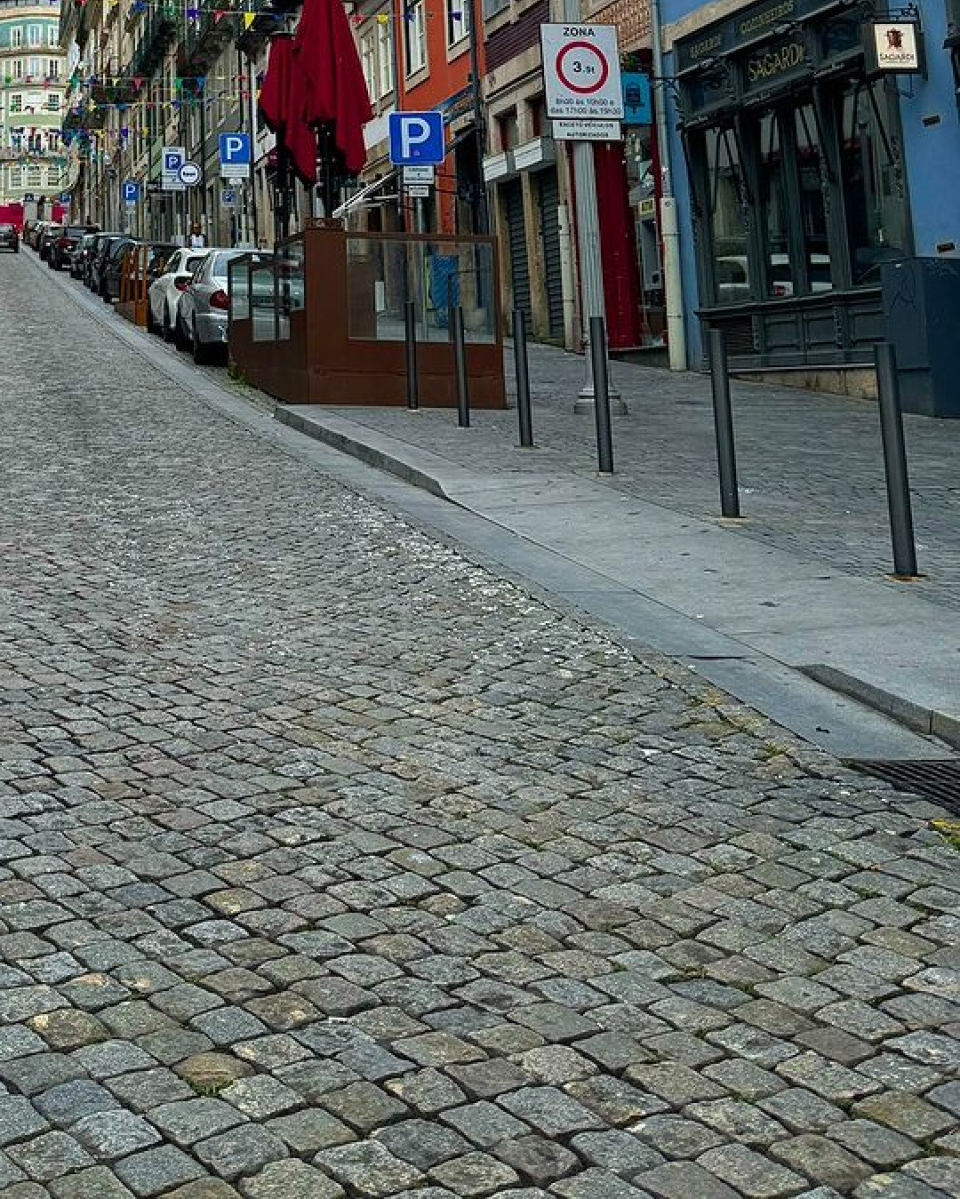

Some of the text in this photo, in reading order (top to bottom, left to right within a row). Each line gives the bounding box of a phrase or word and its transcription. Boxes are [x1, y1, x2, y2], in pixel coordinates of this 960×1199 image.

[563, 27, 596, 37] ZONA
[748, 43, 805, 82] SAGARDI
[879, 52, 915, 61] SAGARDI
[401, 117, 431, 158] P
[226, 137, 243, 160] P
[168, 156, 179, 169] P
[125, 185, 136, 198] P
